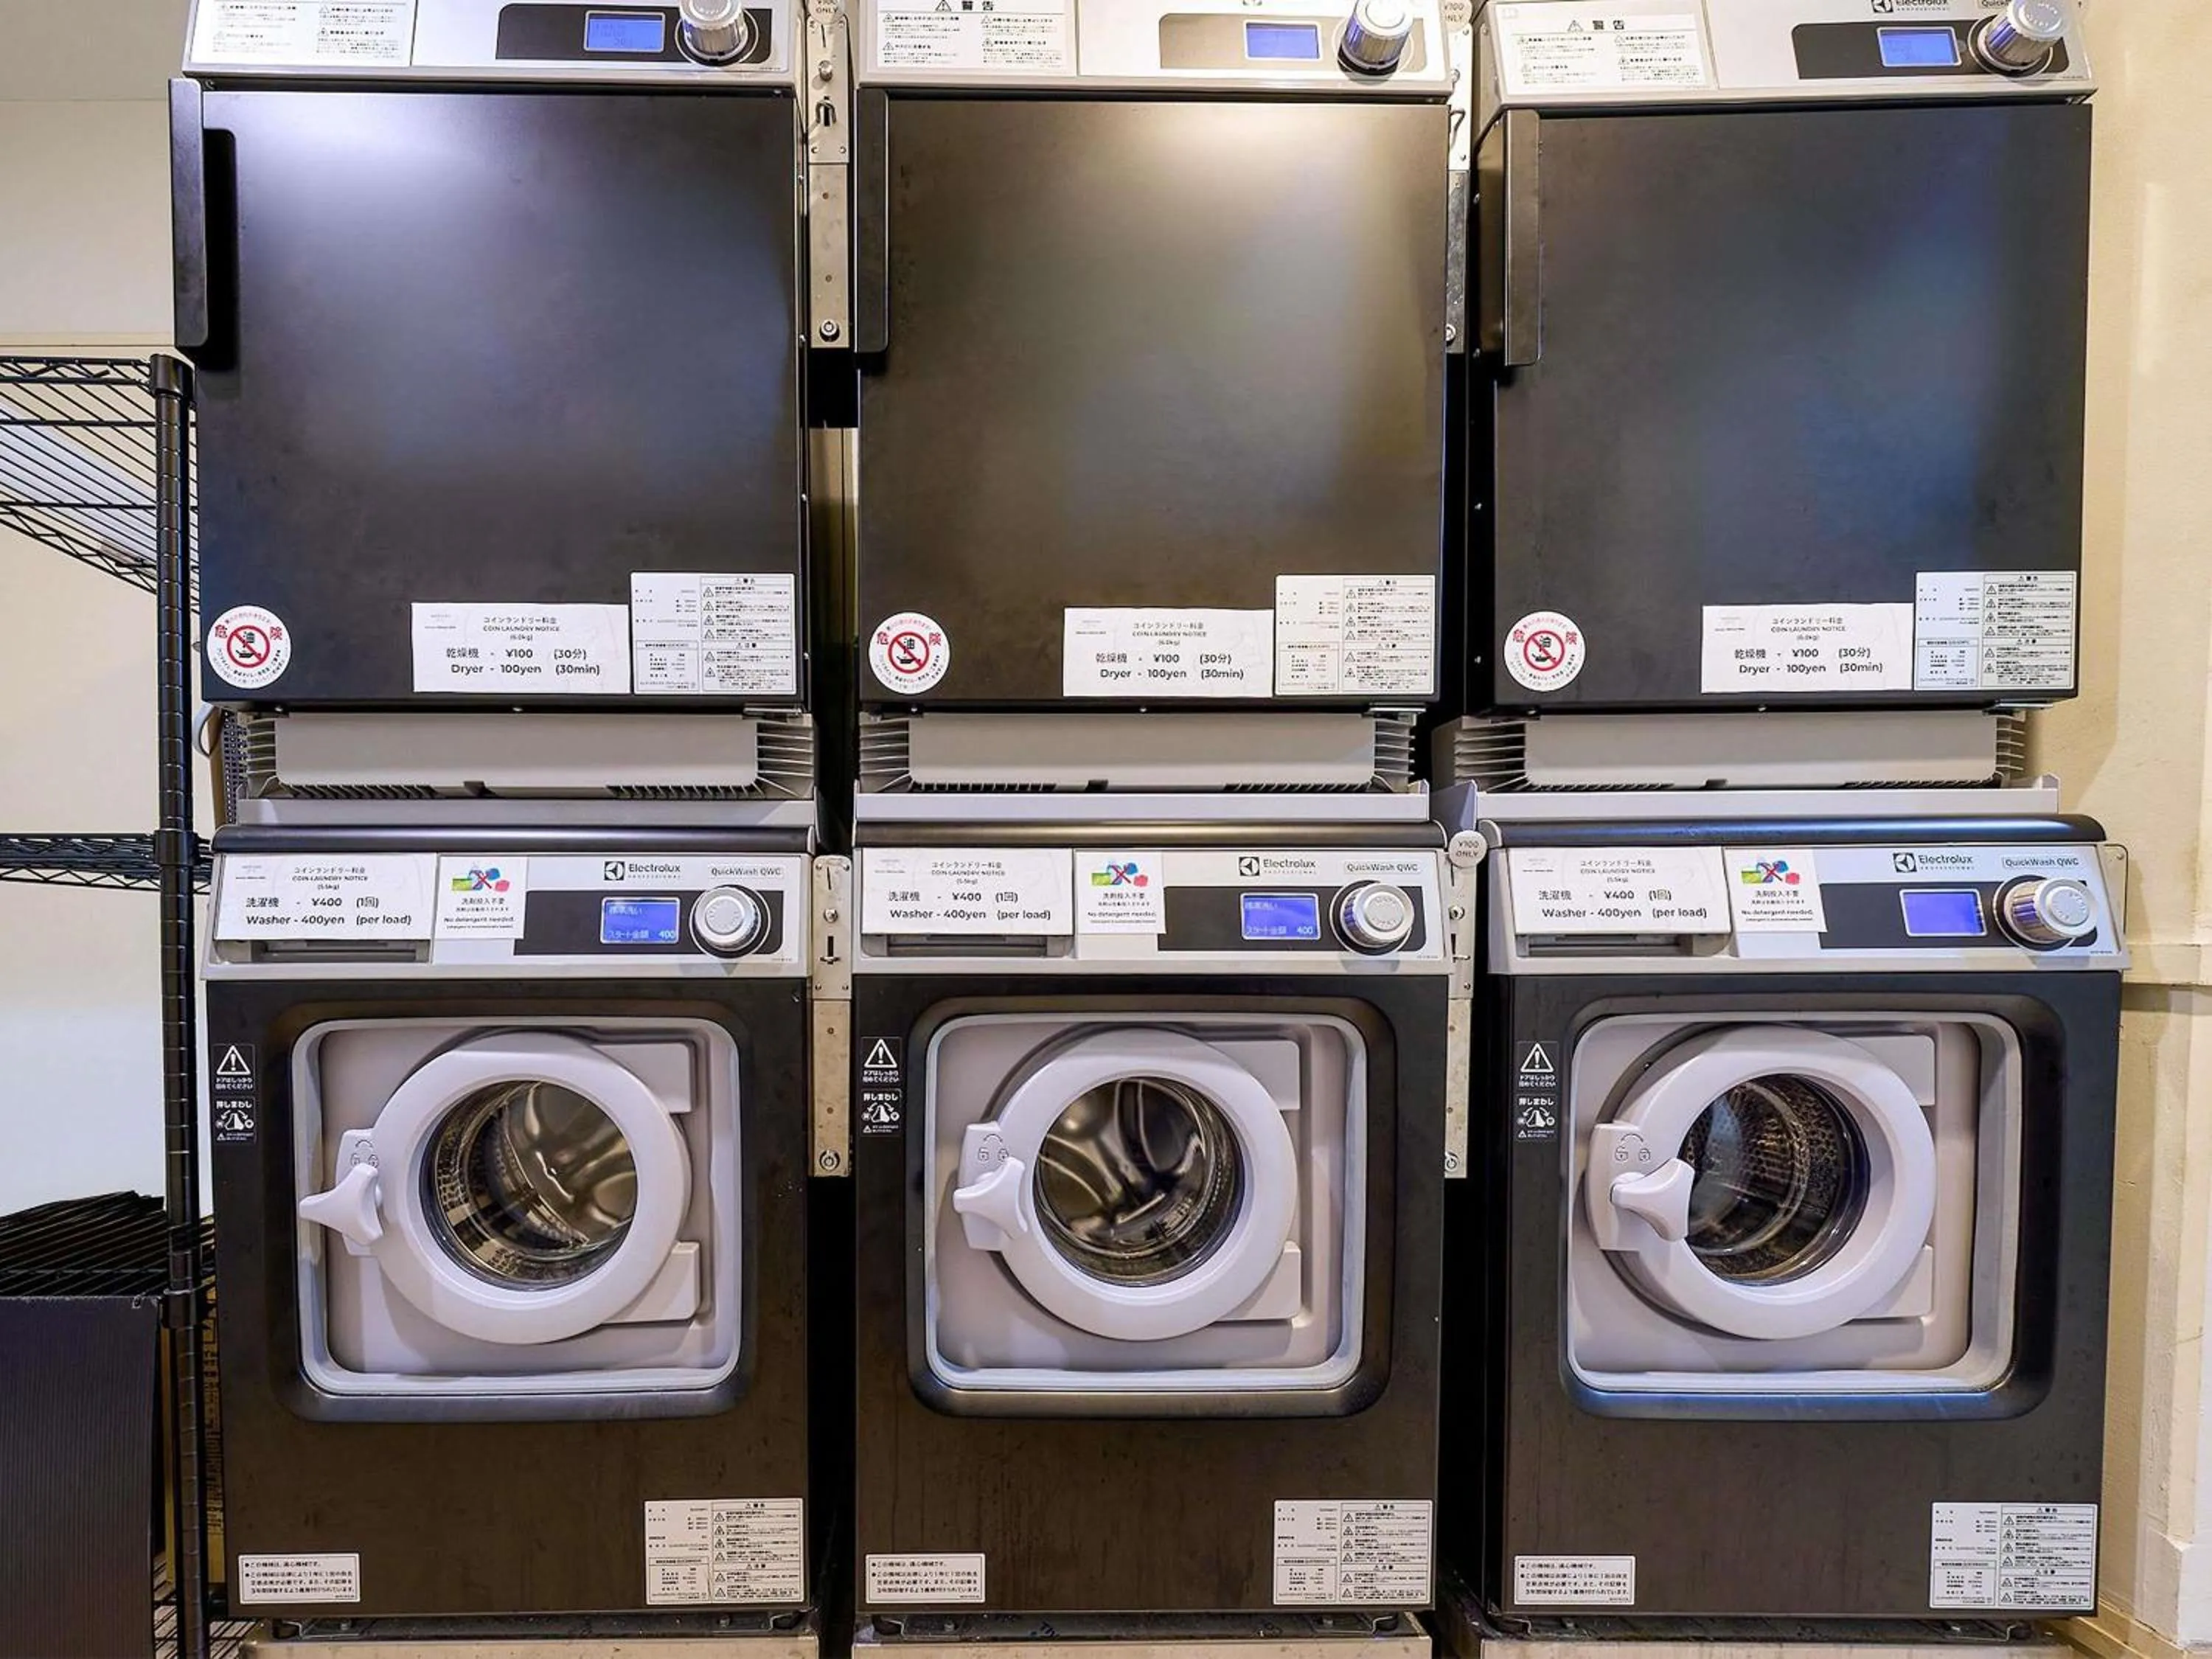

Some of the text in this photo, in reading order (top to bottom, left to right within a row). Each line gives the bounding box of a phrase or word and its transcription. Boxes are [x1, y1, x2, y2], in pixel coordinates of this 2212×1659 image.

[446, 648, 479, 658] 乾燥機
[506, 649, 533, 658] ¥100
[554, 649, 586, 659] (30分)
[1096, 653, 1127, 663] 乾燥機
[1153, 654, 1180, 663] ¥100
[1200, 654, 1231, 664] (30分)
[1735, 649, 1766, 659] 乾燥機
[1792, 649, 1818, 657] ¥100
[1838, 648, 1871, 658] (30分)
[451, 664, 483, 675] Dryer
[501, 665, 541, 675] 100yen
[556, 665, 600, 675] (30min)
[1100, 669, 1131, 680] Dryer
[1147, 669, 1186, 680] 100yen
[1201, 669, 1244, 680] (30min)
[1739, 664, 1770, 675] Dryer
[1787, 664, 1826, 675] 100yen
[1840, 663, 1882, 673] (30min)
[1263, 859, 1316, 868] Electrolux
[1919, 855, 1973, 863] Electrolux
[2057, 858, 2079, 867] QWC
[629, 863, 681, 872] Electrolux
[712, 867, 782, 876] QuickWash QWC
[1347, 863, 1418, 872] QuickWash QWC
[888, 891, 920, 902] 洗濯機
[953, 892, 981, 901] ¥400
[995, 892, 1018, 902] (1回)
[1539, 891, 1571, 900] 洗濯機
[1604, 891, 1634, 900] ¥400
[1649, 890, 1672, 900] (1回)
[246, 897, 279, 908] 洗濯機
[312, 897, 342, 906] ¥400
[356, 897, 379, 908] (1回)
[890, 909, 933, 919] Washer
[943, 909, 986, 920] 400yen
[997, 909, 1020, 920] (per
[1023, 909, 1051, 920] load)
[1542, 908, 1586, 918] Washer
[1598, 908, 1641, 919] 400yen
[1652, 908, 1675, 919] (per
[1678, 908, 1707, 918] load)
[246, 916, 291, 925] Washer
[302, 915, 344, 925] 400yen
[356, 915, 380, 925] (per
[383, 915, 411, 925] load)
[1297, 926, 1313, 935] 400
